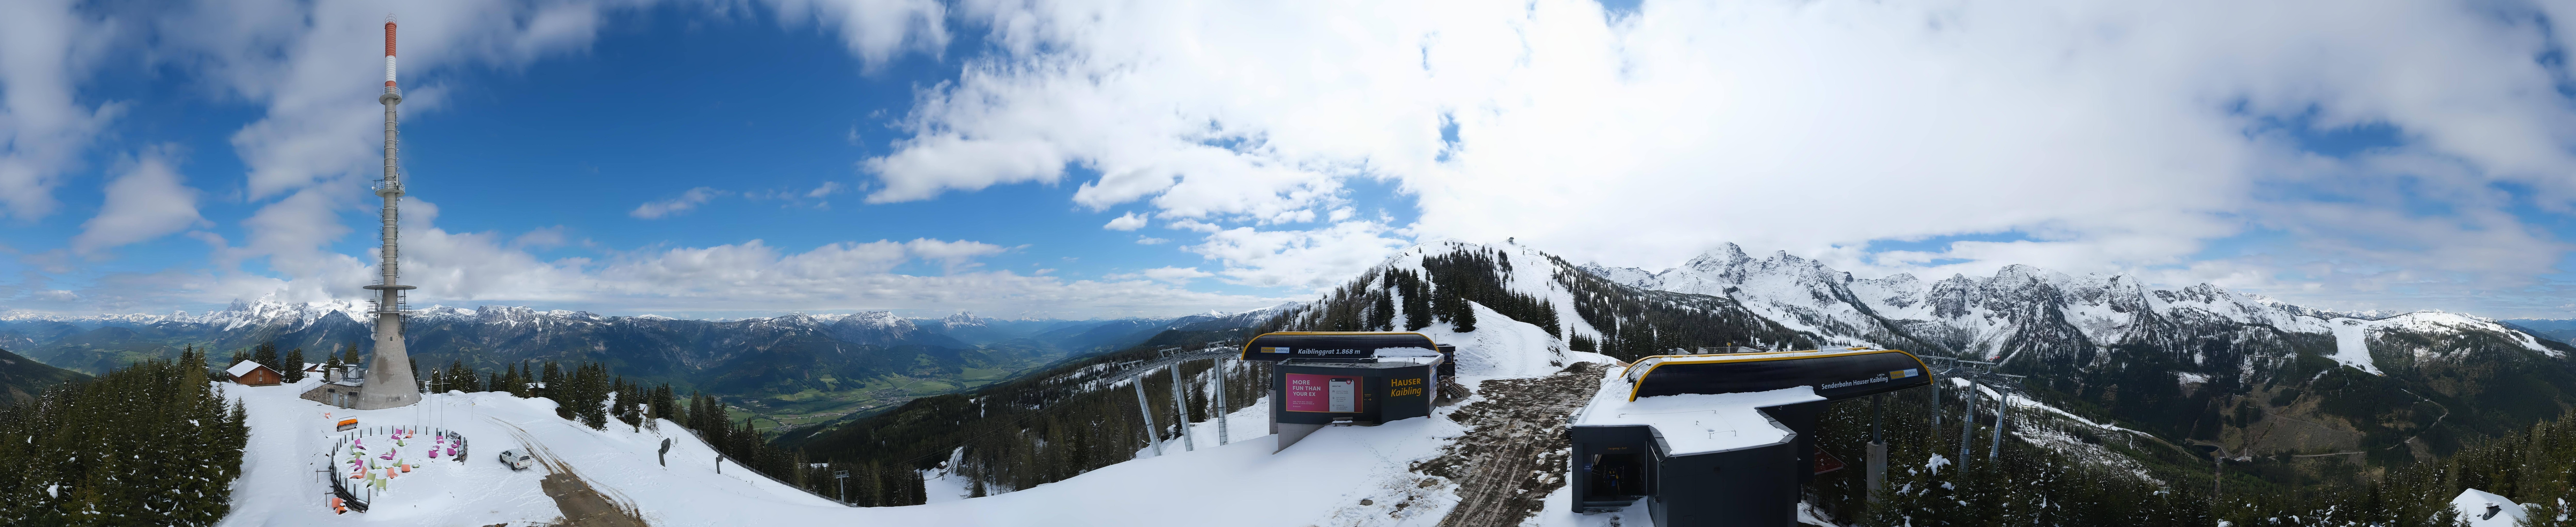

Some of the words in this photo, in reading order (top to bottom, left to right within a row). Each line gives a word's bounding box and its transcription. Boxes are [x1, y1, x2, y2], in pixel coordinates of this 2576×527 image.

[1391, 378, 1421, 387] HAUSER
[1821, 381, 1852, 389] Senderbahn
[1391, 387, 1421, 397] Kaibling
